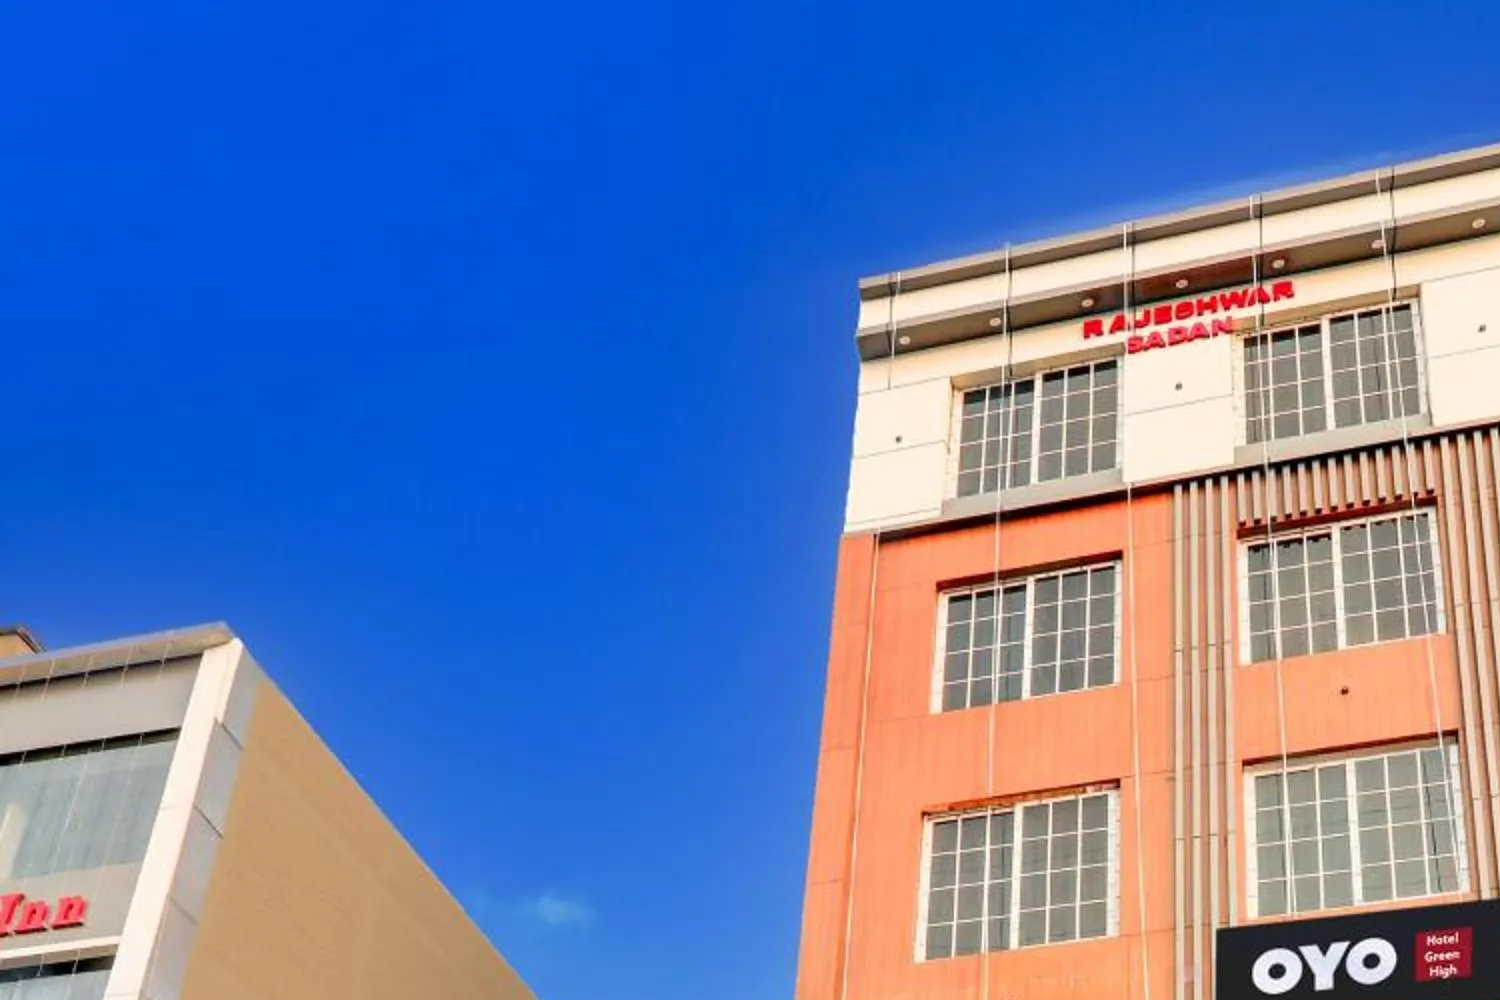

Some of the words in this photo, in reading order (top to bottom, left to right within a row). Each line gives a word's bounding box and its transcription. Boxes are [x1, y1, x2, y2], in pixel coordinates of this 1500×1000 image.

[1083, 280, 1295, 340] RAJESHWAR
[1127, 316, 1234, 355] SADAN
[1426, 931, 1459, 947] Hotel
[1251, 937, 1398, 995] OYO
[1423, 951, 1461, 963] Green
[1429, 963, 1458, 979] High
